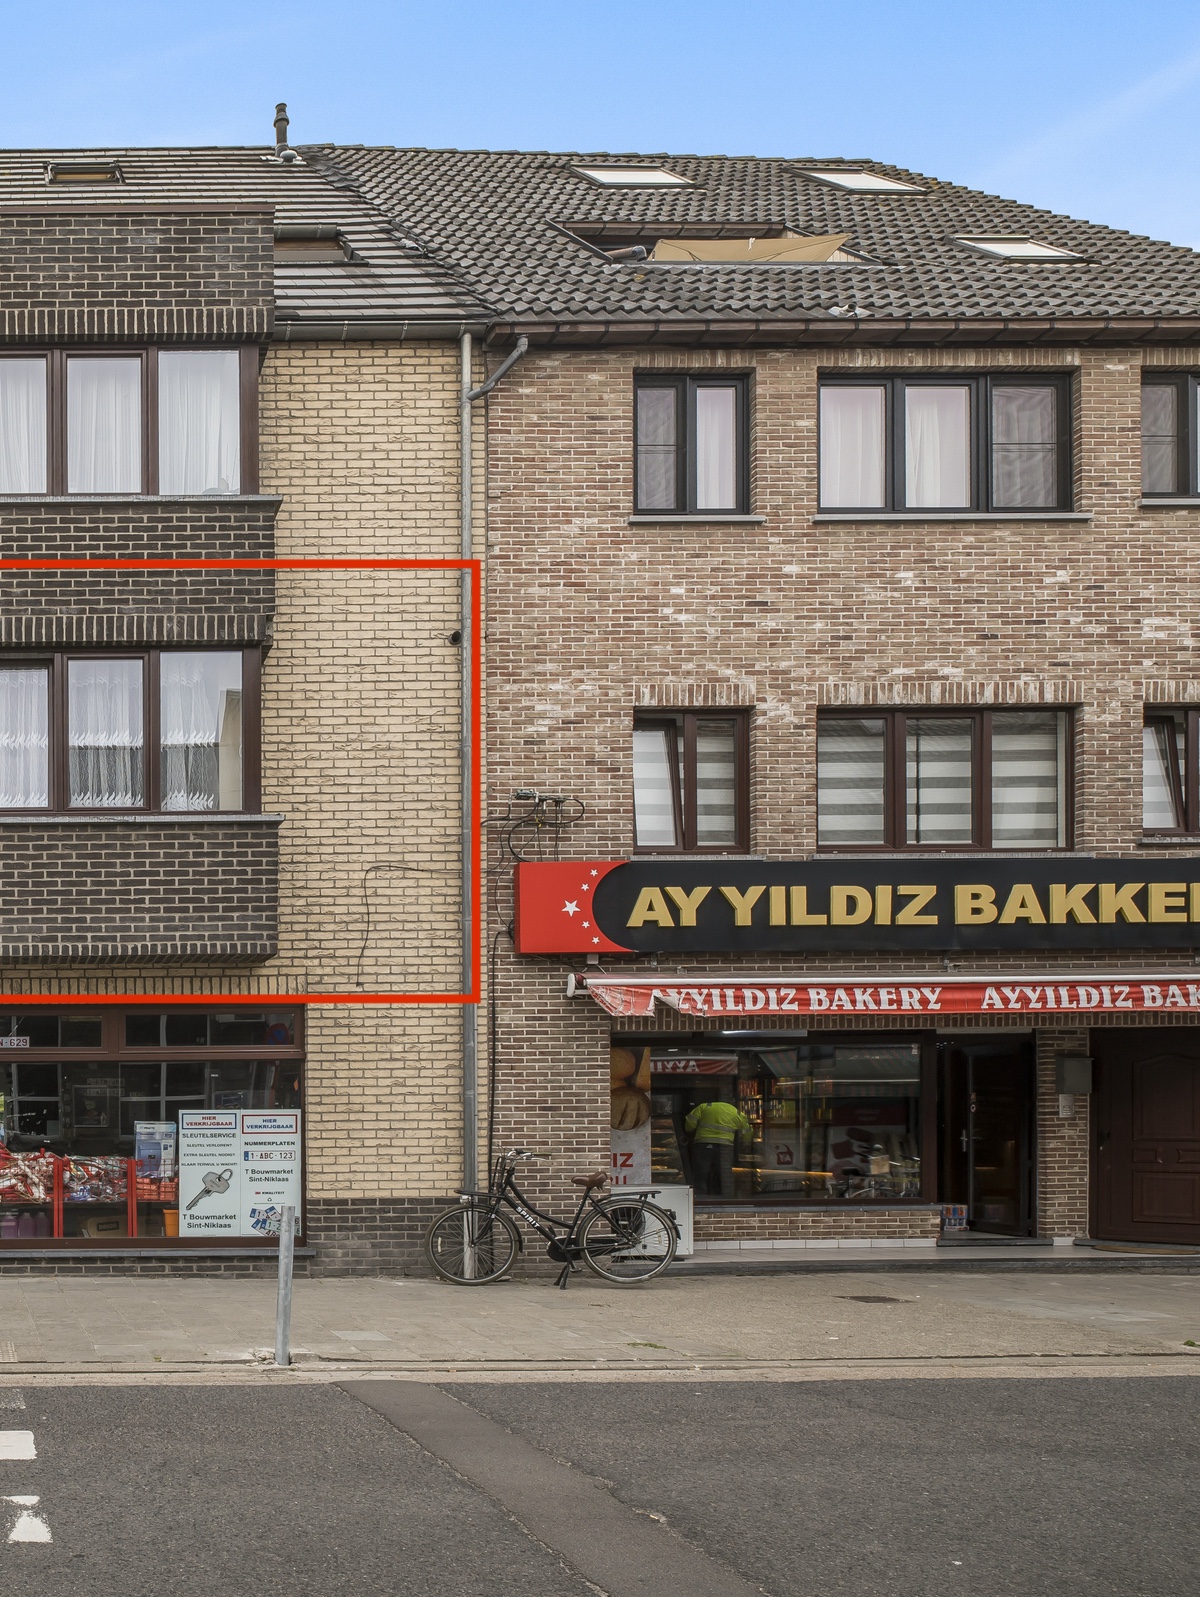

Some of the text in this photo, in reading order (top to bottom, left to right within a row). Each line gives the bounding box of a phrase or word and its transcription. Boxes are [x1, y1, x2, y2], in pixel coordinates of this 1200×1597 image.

[718, 885, 938, 927] YILDIZ
[954, 882, 1200, 925] BAKKE
[808, 987, 942, 1011] BAKERY
[981, 985, 1133, 1009] AYYILDIZ
[515, 1206, 541, 1229] SPIRIT
